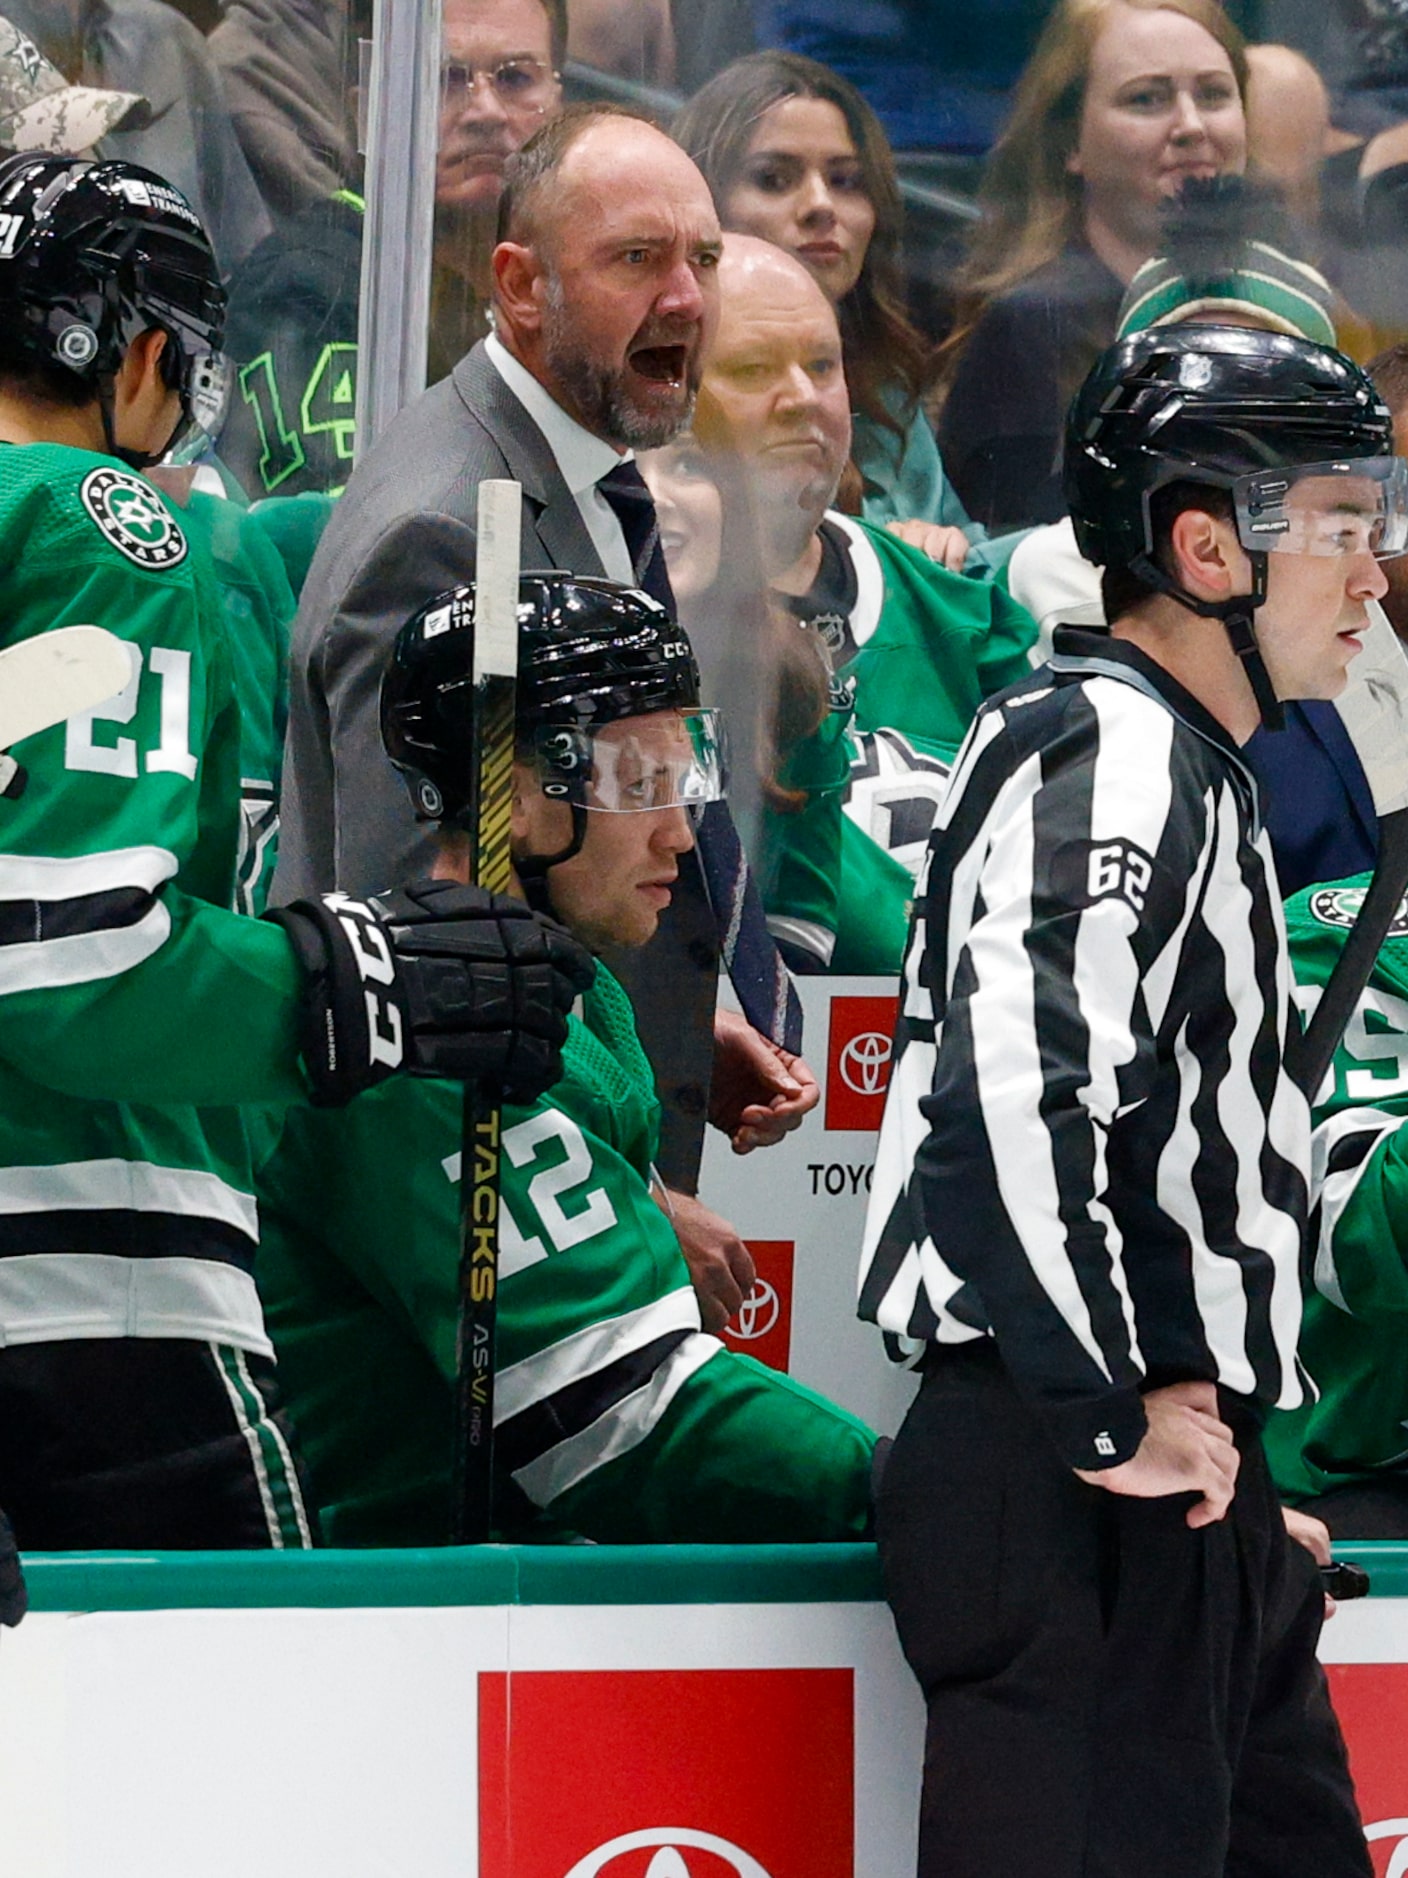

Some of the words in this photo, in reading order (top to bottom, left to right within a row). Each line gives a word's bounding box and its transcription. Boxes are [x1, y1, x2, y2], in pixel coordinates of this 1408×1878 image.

[239, 342, 359, 493] 14
[103, 518, 181, 561] STARS
[65, 640, 199, 782] 21
[1087, 844, 1153, 912] 62
[325, 1007, 337, 1072] ROBERTSON
[440, 1107, 619, 1281] 12
[470, 1110, 499, 1303] TACKS
